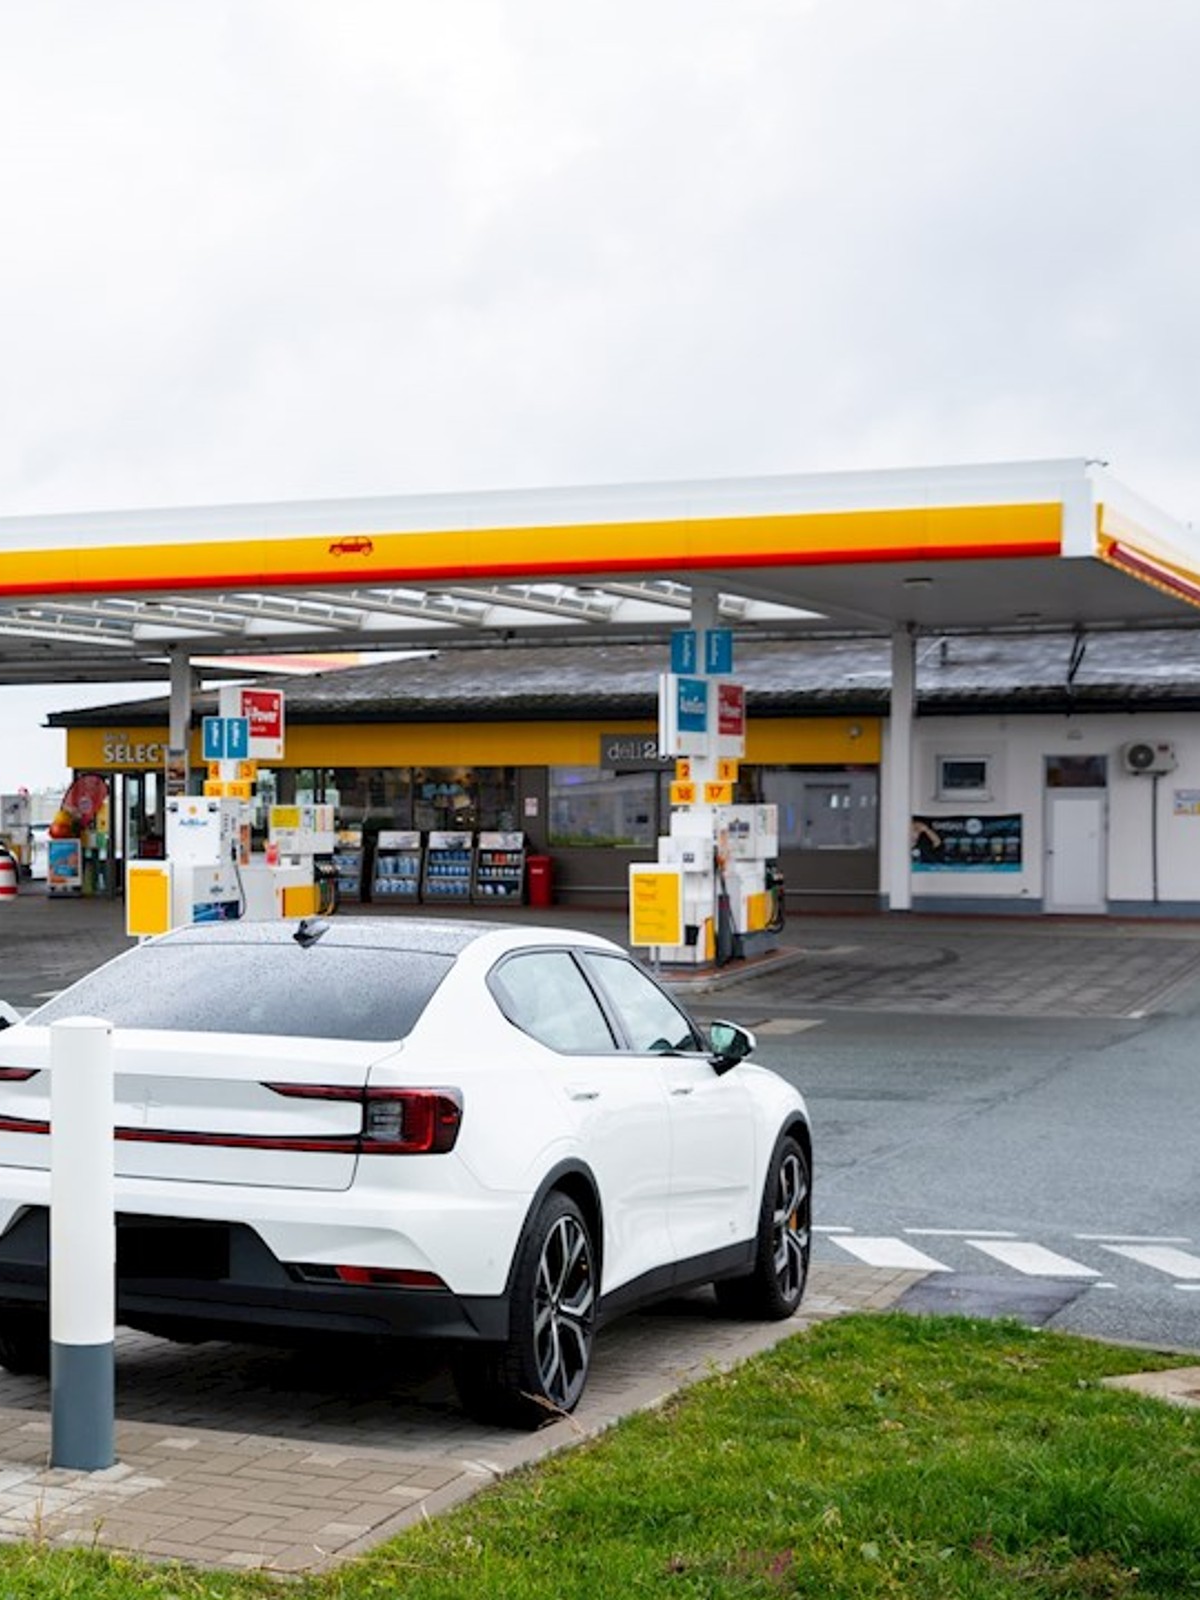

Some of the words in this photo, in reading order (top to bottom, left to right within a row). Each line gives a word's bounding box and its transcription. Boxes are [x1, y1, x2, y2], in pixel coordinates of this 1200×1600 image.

[681, 764, 689, 777] 2
[677, 787, 692, 800] 18
[708, 786, 723, 799] 17
